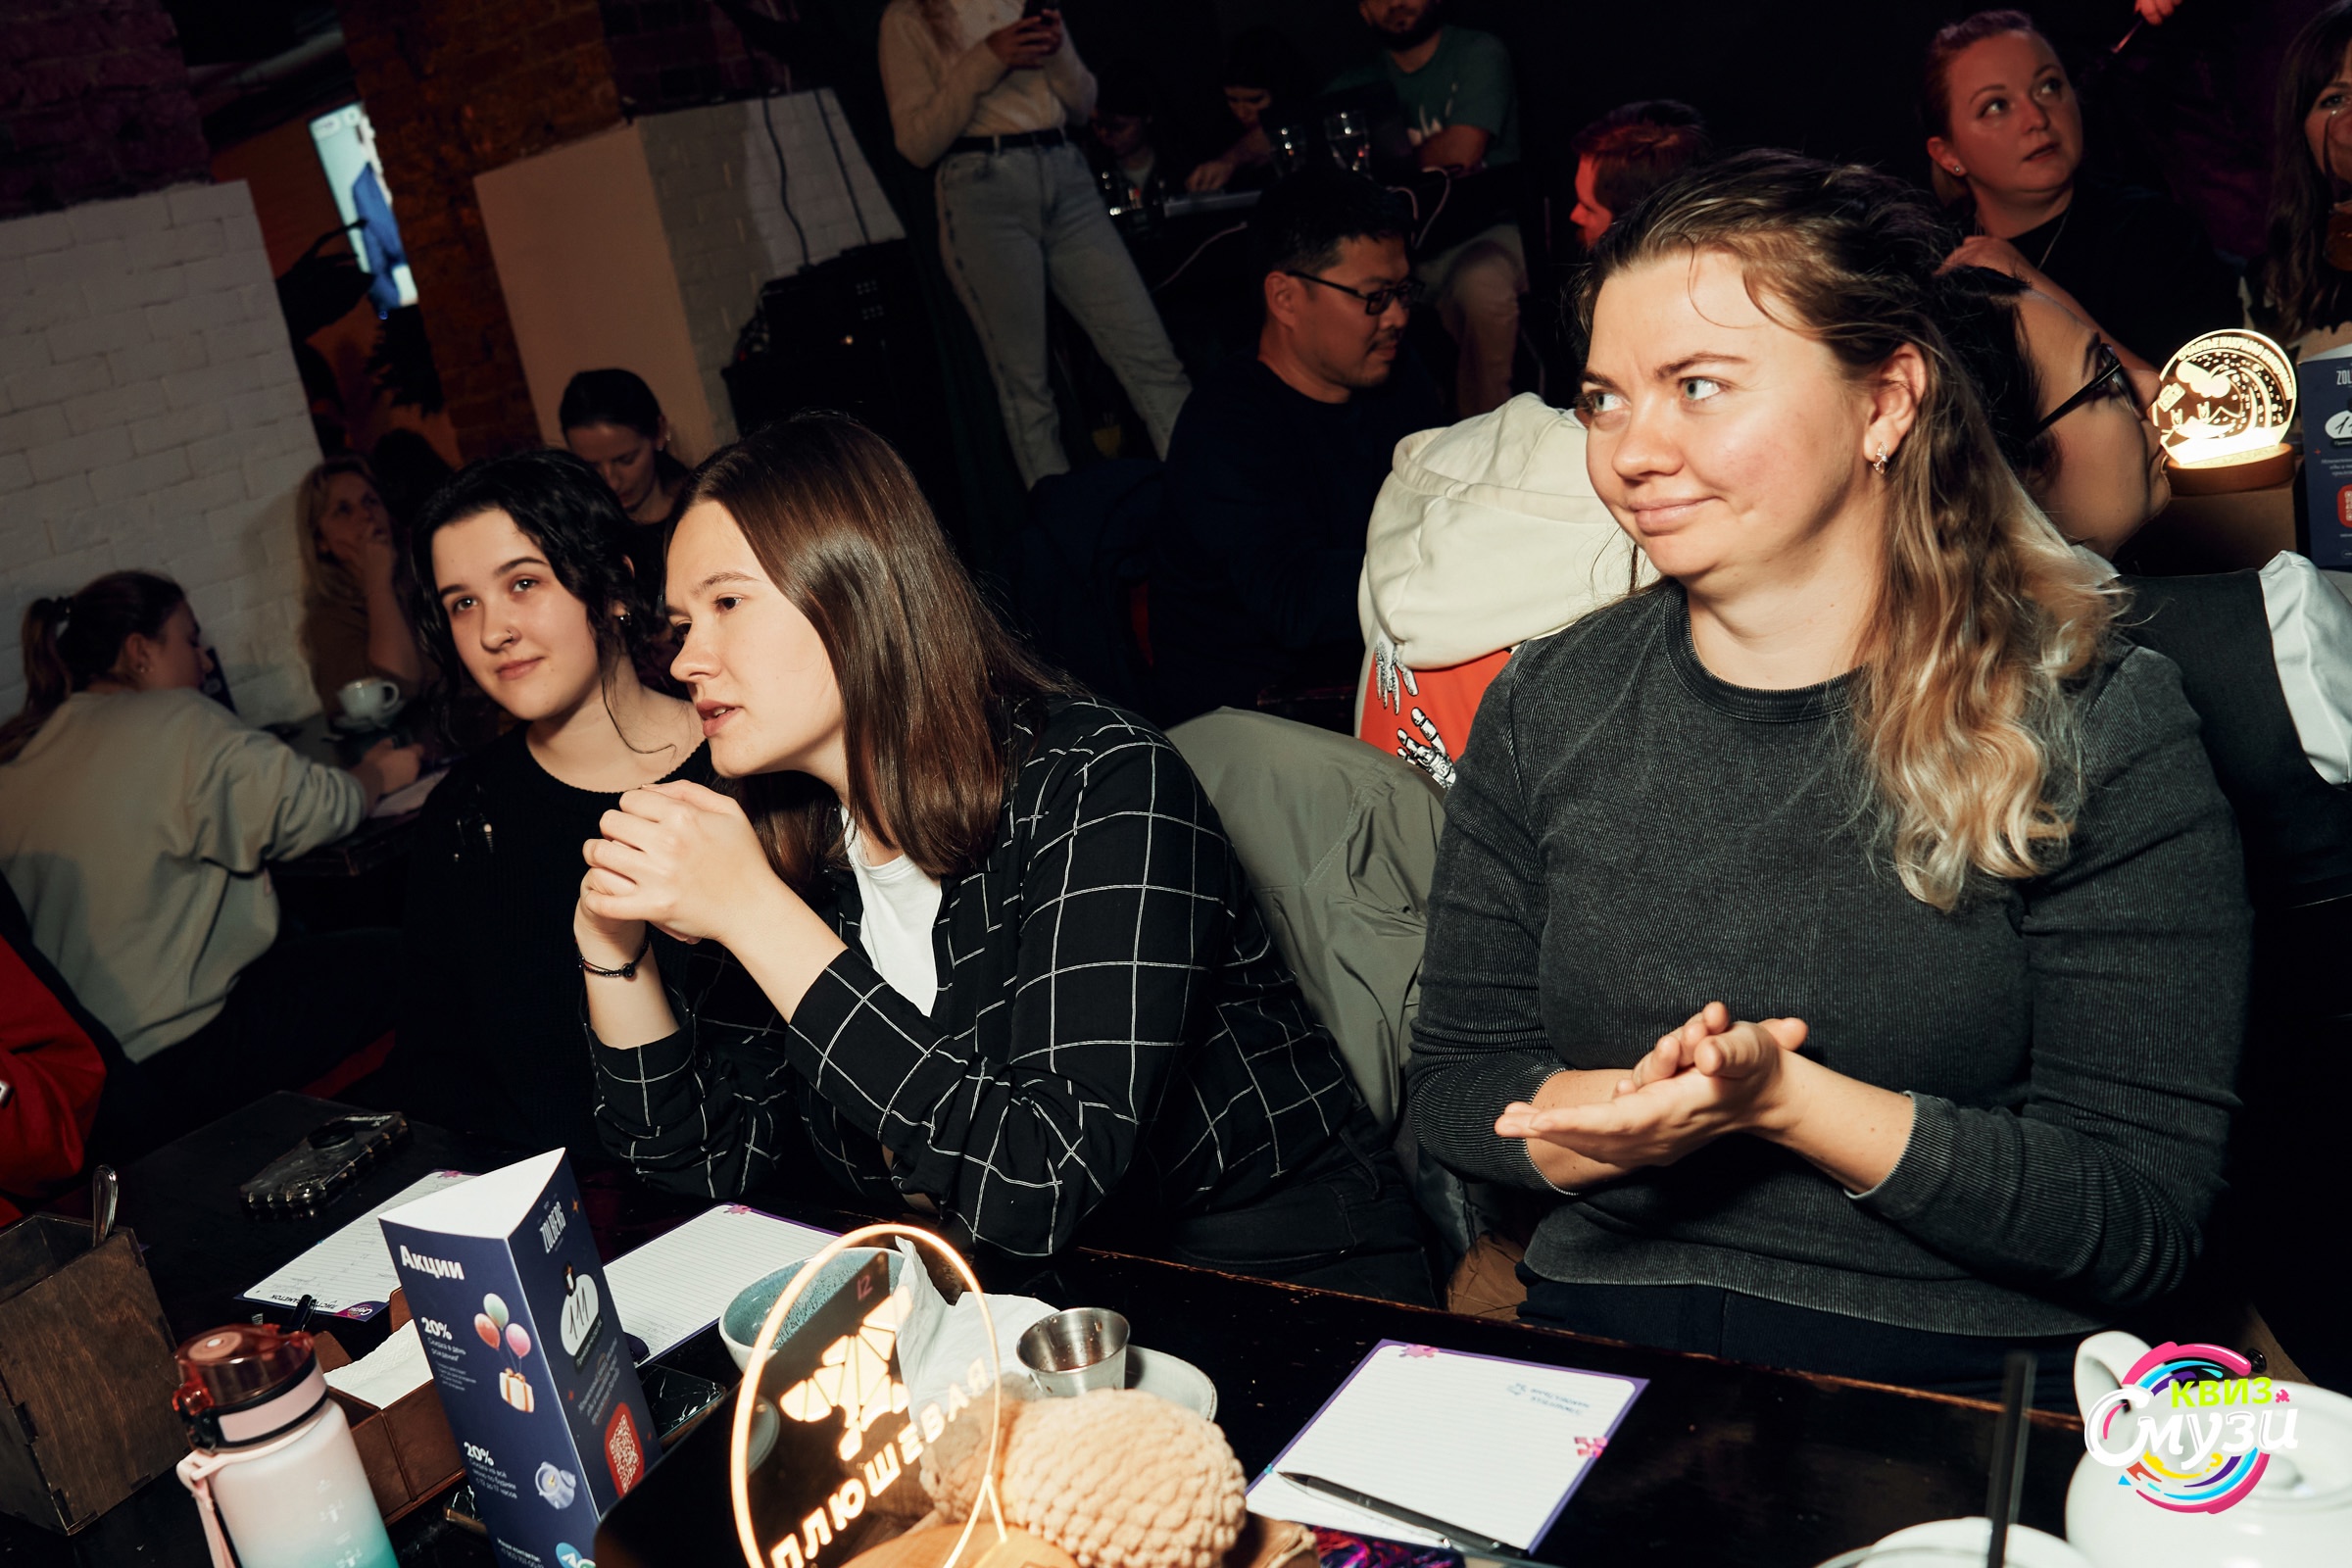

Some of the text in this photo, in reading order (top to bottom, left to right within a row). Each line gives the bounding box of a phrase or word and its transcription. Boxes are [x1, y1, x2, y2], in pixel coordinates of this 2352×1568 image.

[400, 1245, 466, 1281] Акции
[420, 1316, 453, 1341] 20%
[464, 1441, 494, 1466] 20%
[770, 1355, 990, 1568] ПЛЮШЕВАЯ
